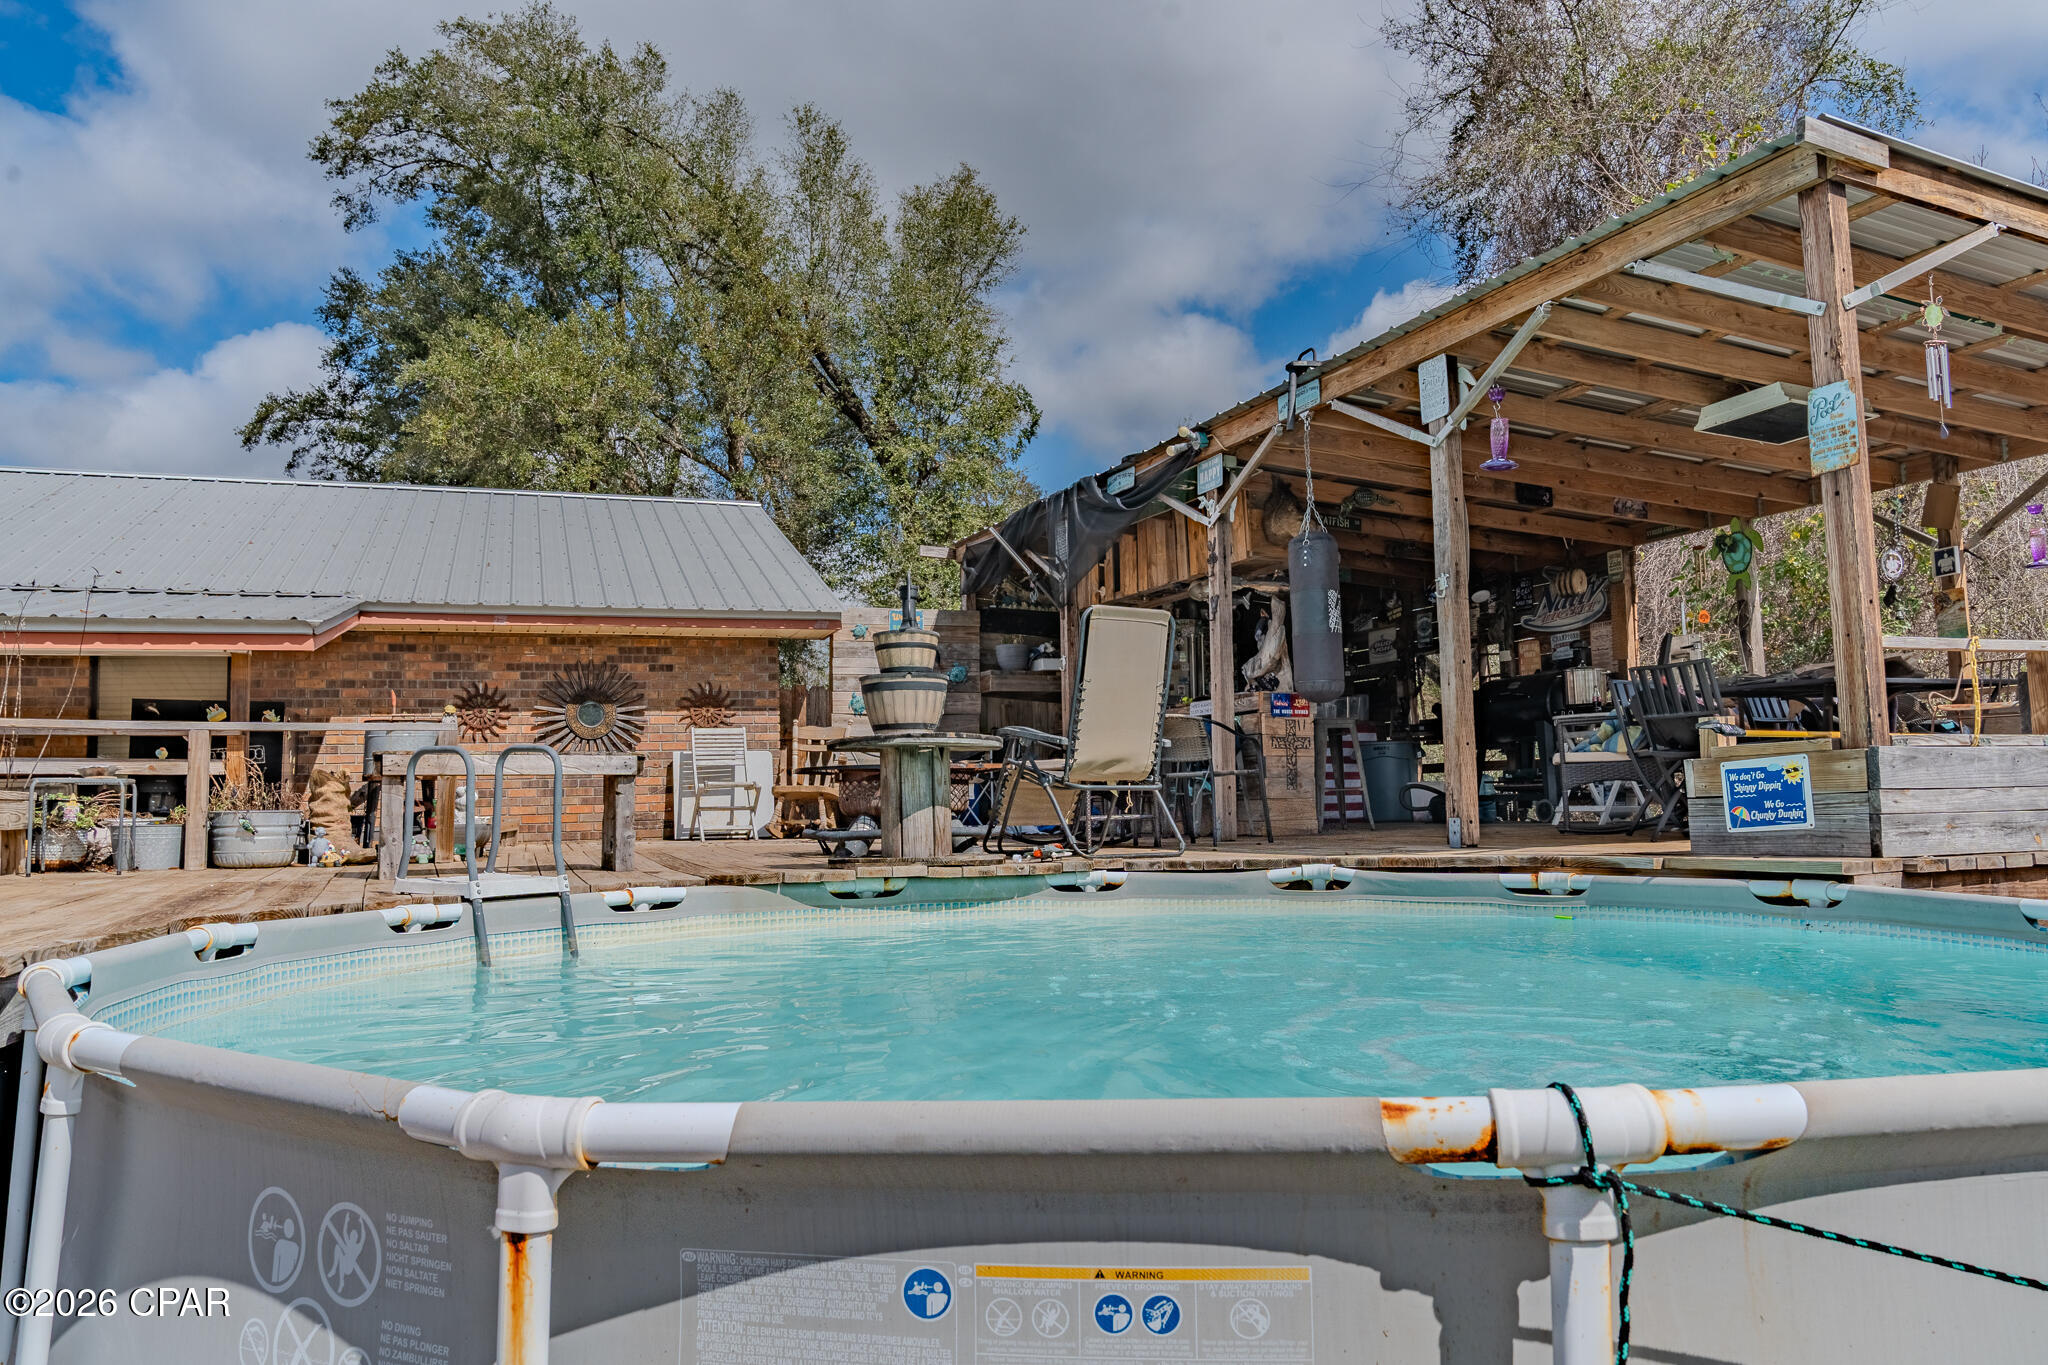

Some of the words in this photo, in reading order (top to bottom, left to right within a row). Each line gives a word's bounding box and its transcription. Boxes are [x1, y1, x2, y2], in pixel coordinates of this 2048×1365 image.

[1810, 392, 1842, 426] Pool
[1199, 465, 1220, 484] HAPPY
[1729, 772, 1739, 781] We
[1739, 771, 1755, 781] don't
[1755, 771, 1765, 780] Go
[1763, 800, 1774, 808] We
[1775, 800, 1785, 808] Go
[385, 1212, 397, 1223] NO
[398, 1215, 434, 1229] JUMPING
[386, 1225, 397, 1236] NE
[398, 1227, 414, 1239] PAS
[386, 1238, 398, 1249] NO
[399, 1240, 430, 1254] SALTAR
[386, 1251, 409, 1264] NICHT
[410, 1255, 453, 1273] SPRINGEN
[696, 1251, 739, 1265] WARNING:
[740, 1256, 769, 1267] CHILDREN
[770, 1258, 787, 1268] HAVE
[828, 1261, 862, 1273] PORTABLE
[862, 1263, 896, 1274] SWIMMING
[385, 1264, 403, 1277] NON
[403, 1267, 440, 1283] SALTATE
[697, 1273, 716, 1283] LEAVE
[716, 1274, 745, 1284] CHILDREN
[800, 1280, 810, 1289] OR
[811, 1280, 838, 1290] AROUND
[840, 1281, 854, 1290] THE
[719, 1265, 743, 1275] ENSURE
[743, 1266, 764, 1277] ACTIVE
[787, 1269, 827, 1280] SUPERVISION
[827, 1271, 836, 1280] AT
[837, 1272, 849, 1281] ALL
[872, 1273, 882, 1282] DO
[883, 1274, 897, 1284] NOT
[1115, 1271, 1164, 1280] WARNING
[385, 1278, 402, 1290] NIET
[403, 1281, 446, 1298] SPRINGEN
[981, 1280, 993, 1289] NO
[994, 1280, 1022, 1290] DIVING
[1022, 1281, 1035, 1290] OR
[1036, 1280, 1073, 1290] JUMPING
[992, 1287, 1032, 1296] SHALLOW
[1033, 1287, 1062, 1297] WATER
[1094, 1282, 1132, 1292] PREVENT
[1134, 1282, 1180, 1292] DROWNING
[1219, 1288, 1256, 1298] SUCTION
[778, 1287, 794, 1297] POOL
[842, 1291, 863, 1301] APPLY
[864, 1292, 874, 1302] TO
[744, 1295, 760, 1305] YOUR
[761, 1296, 782, 1306] LOCAL
[782, 1296, 826, 1308] GOVERNMENT
[863, 1302, 877, 1312] FOR
[750, 1314, 763, 1323] NOT
[771, 1305, 797, 1316] ALWAYS
[797, 1306, 824, 1317] REMOVE
[824, 1308, 850, 1319] LADDER
[851, 1310, 865, 1320] AND
[381, 1319, 394, 1331] NO
[394, 1322, 422, 1337] DIVING
[696, 1319, 746, 1335] ATTENTION:
[760, 1327, 788, 1338] ENFANTS
[788, 1329, 798, 1338] SE
[798, 1329, 815, 1340] SONT
[379, 1346, 391, 1357] NO
[380, 1333, 392, 1344] NE
[392, 1335, 408, 1348] PAS
[409, 1339, 449, 1357] PLONGER
[747, 1335, 772, 1347] CHAQUE
[820, 1340, 867, 1354] SURVEILLANCE
[868, 1343, 891, 1355] ACTIVE
[892, 1345, 906, 1356] PAR
[743, 1344, 755, 1354] LES
[755, 1345, 784, 1356] ENFANTS
[802, 1348, 849, 1361] SURVEILLANCE
[877, 1353, 905, 1365] AUTOUR
